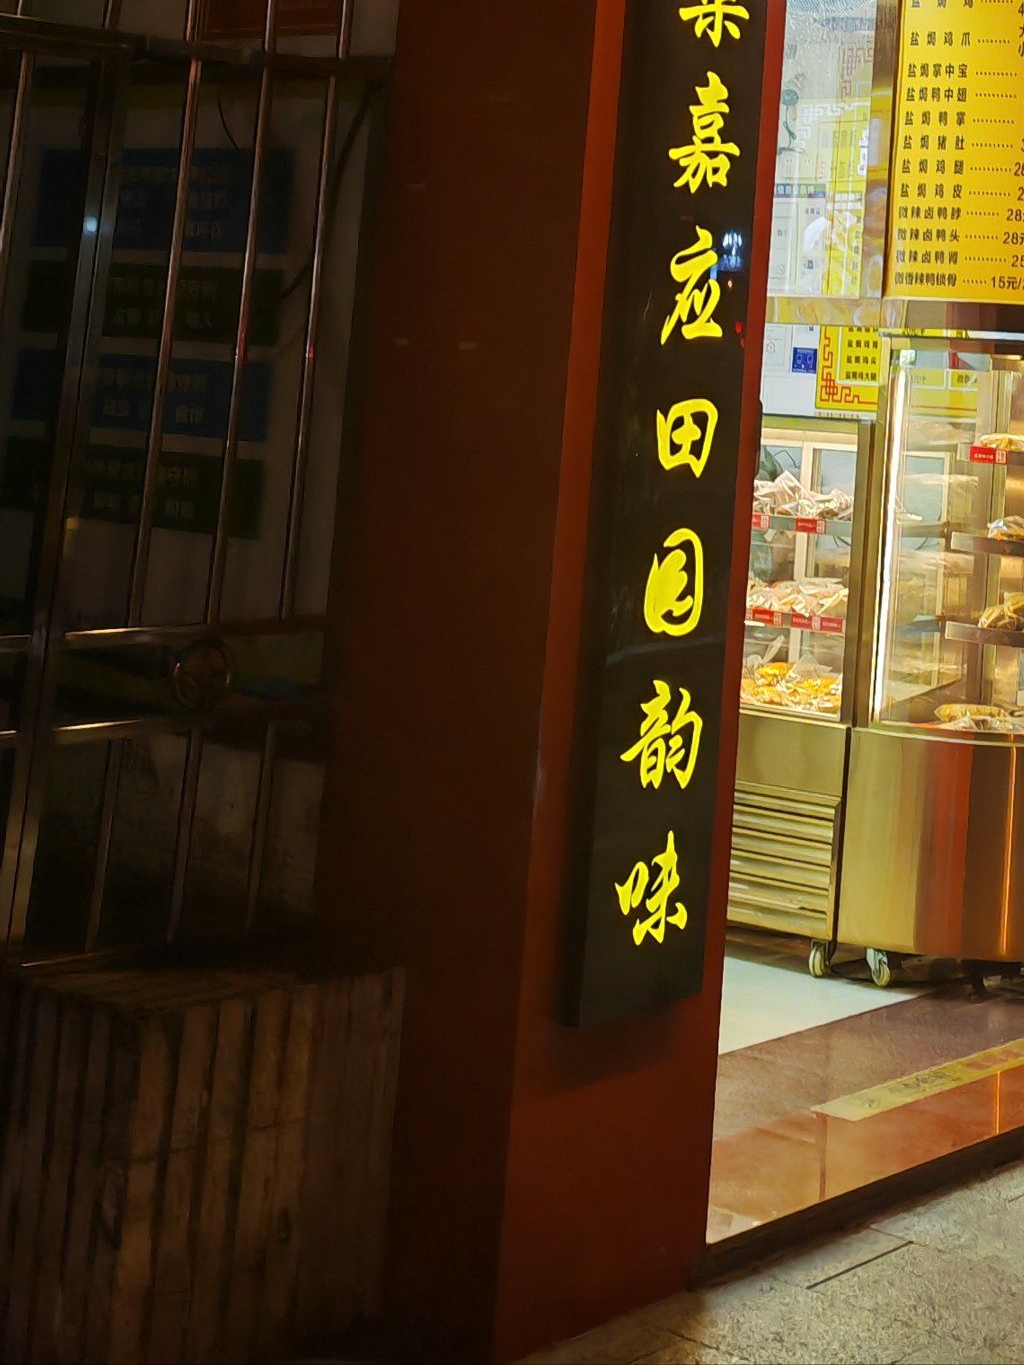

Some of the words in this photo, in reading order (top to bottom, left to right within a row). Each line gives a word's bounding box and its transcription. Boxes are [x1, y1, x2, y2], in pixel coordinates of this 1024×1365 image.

[910, 31, 971, 47] 盐焗鸡爪
[903, 134, 965, 151] 盐焗猪肚
[900, 183, 963, 199] 盐焗鸡皮
